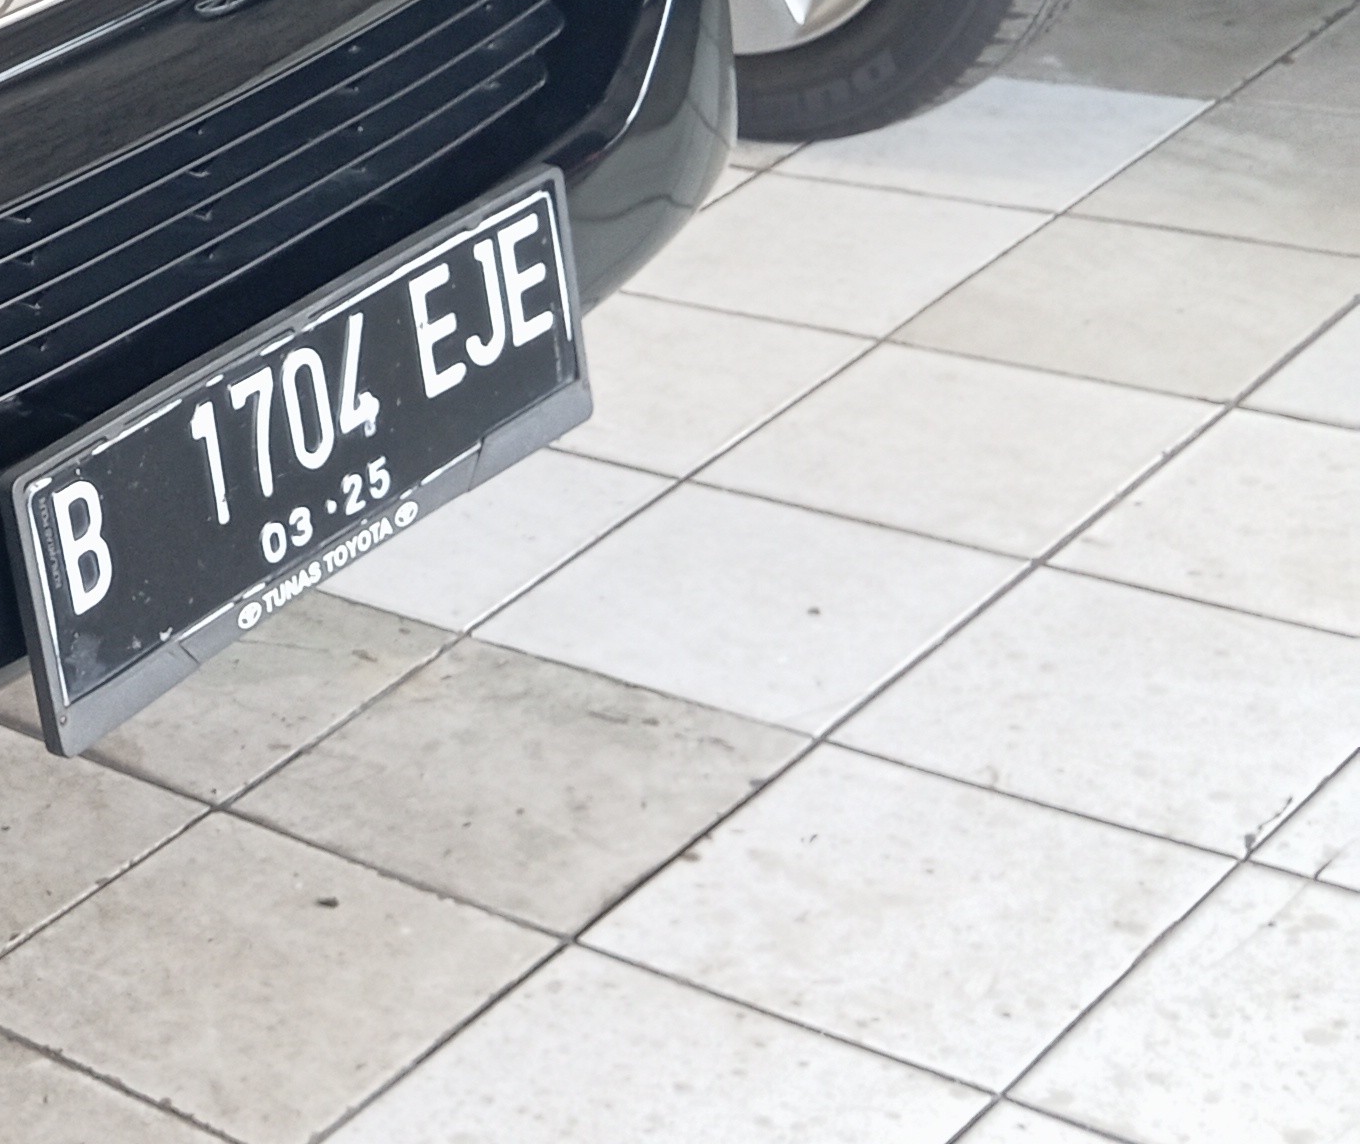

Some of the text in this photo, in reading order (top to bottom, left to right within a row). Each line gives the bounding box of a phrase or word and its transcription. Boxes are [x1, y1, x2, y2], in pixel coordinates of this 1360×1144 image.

[52, 481, 112, 615] B
[190, 312, 380, 525] 1704
[408, 213, 554, 399] EJE
[262, 517, 394, 613] TUNAS TOYOTA
